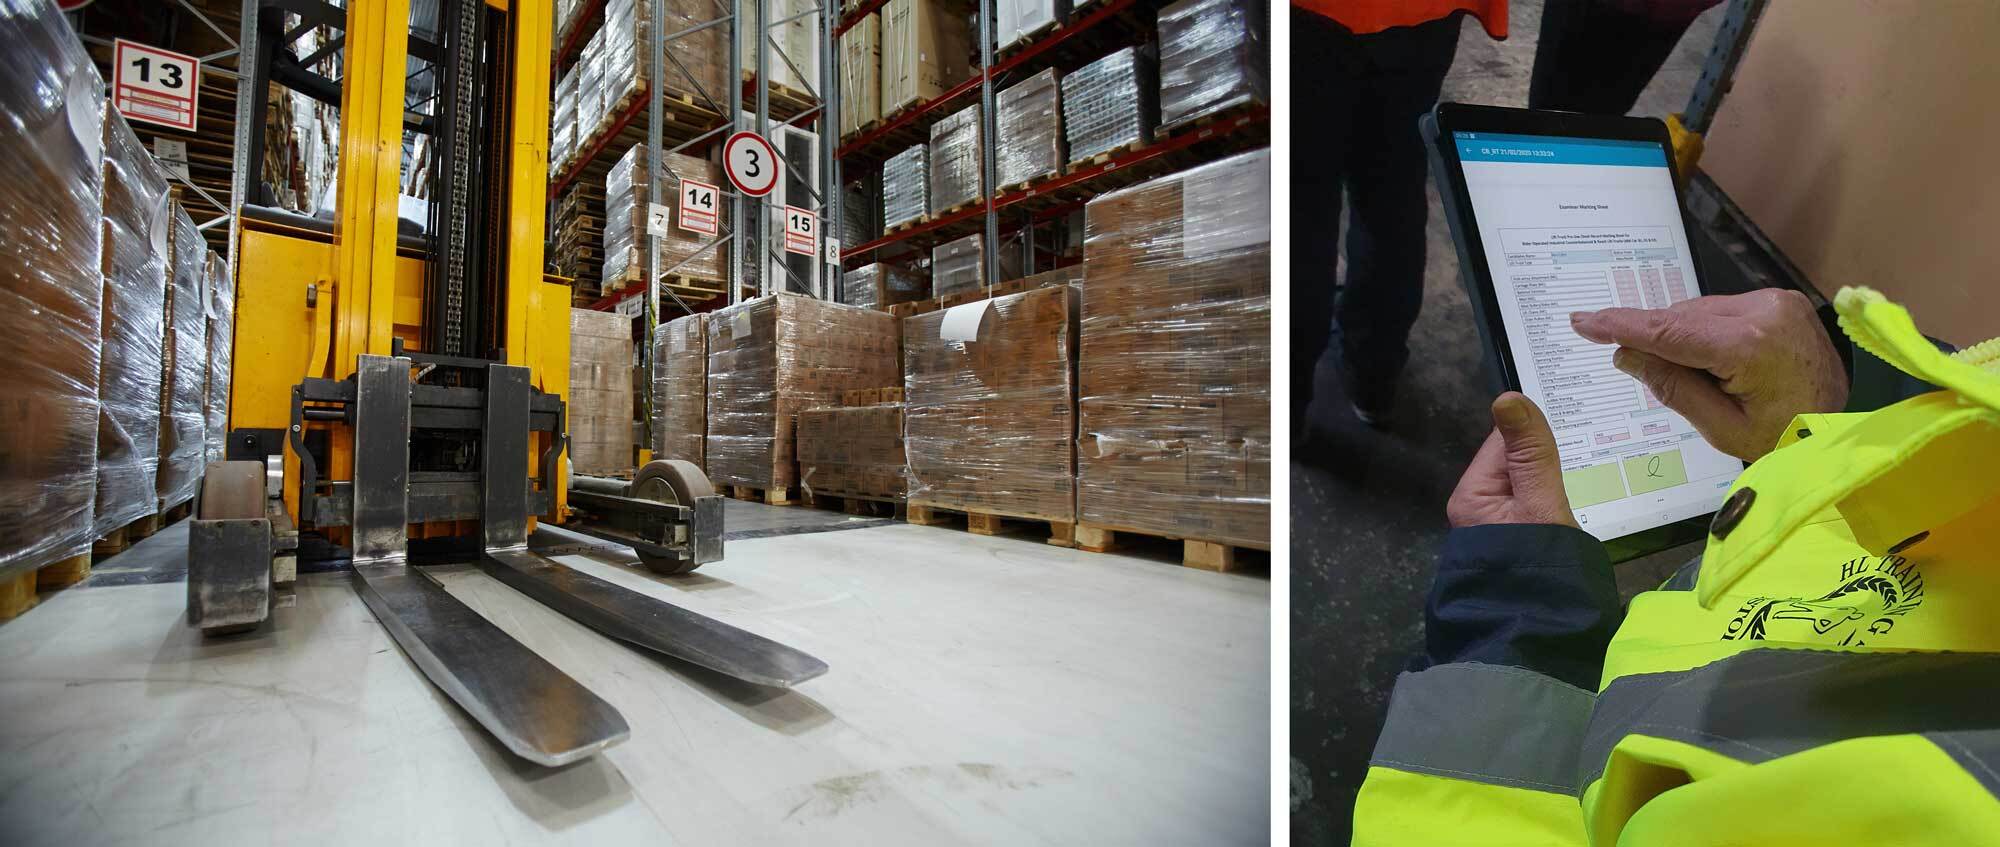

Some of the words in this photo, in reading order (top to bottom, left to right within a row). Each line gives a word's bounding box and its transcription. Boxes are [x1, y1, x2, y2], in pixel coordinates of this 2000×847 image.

[132, 57, 184, 89] 13
[744, 149, 761, 178] 3
[688, 188, 713, 210] 14
[655, 213, 664, 226] 7
[791, 214, 811, 232] 15
[829, 245, 838, 258] 8
[1840, 556, 1870, 582] HL
